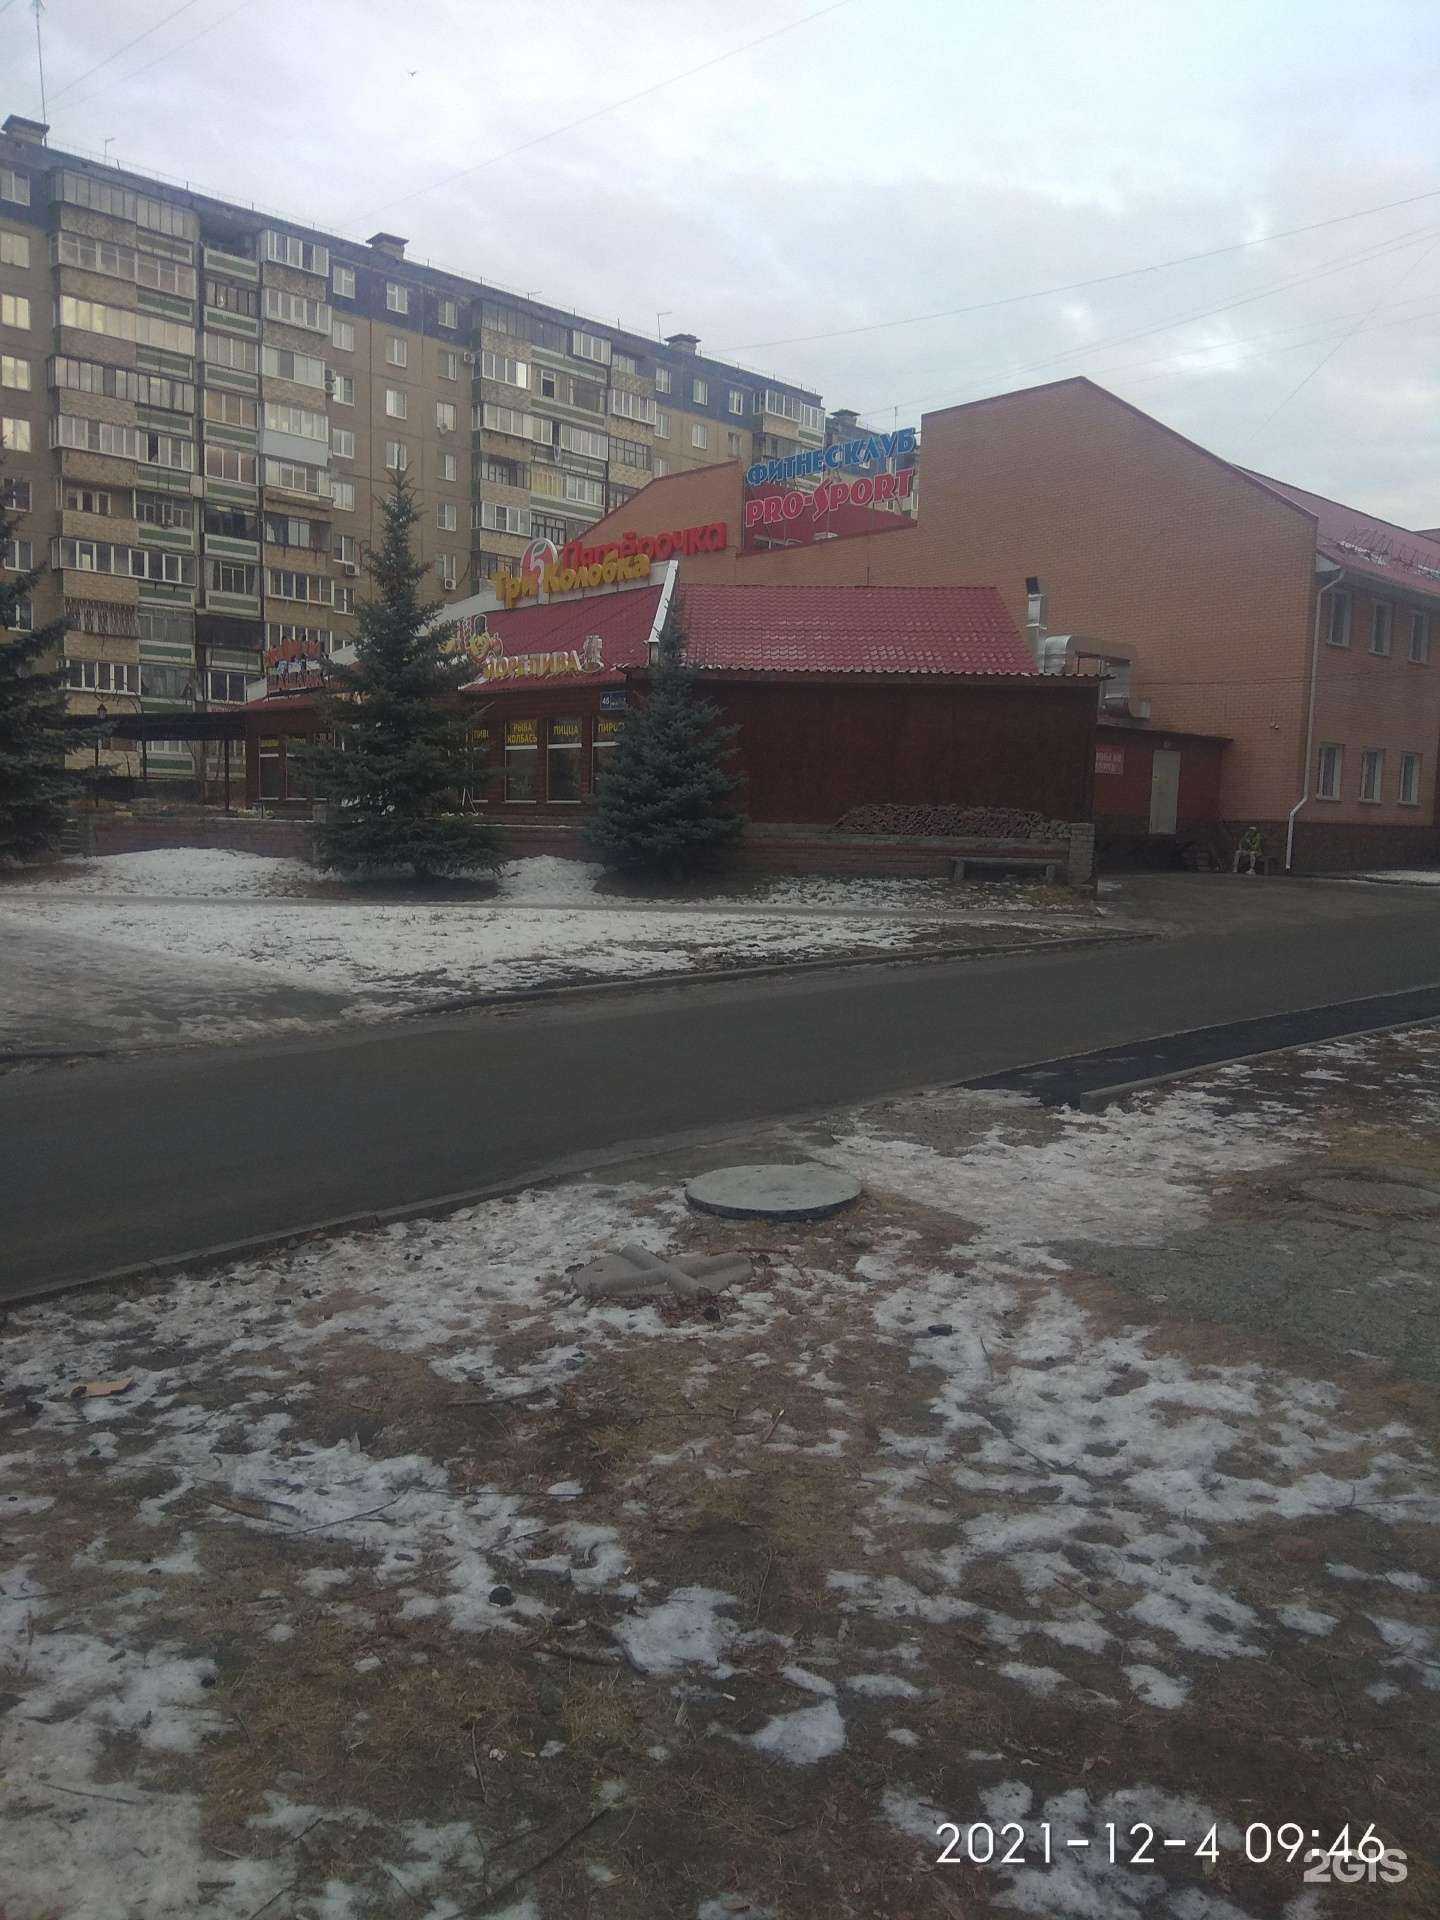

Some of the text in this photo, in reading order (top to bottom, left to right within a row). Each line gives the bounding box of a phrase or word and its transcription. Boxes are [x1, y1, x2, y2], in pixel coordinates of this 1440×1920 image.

[746, 427, 916, 486] ФИТНЕСКЛУБ
[543, 549, 650, 594] Колобка
[513, 722, 533, 734] РЫБА
[553, 725, 579, 736] ПИЦЦА
